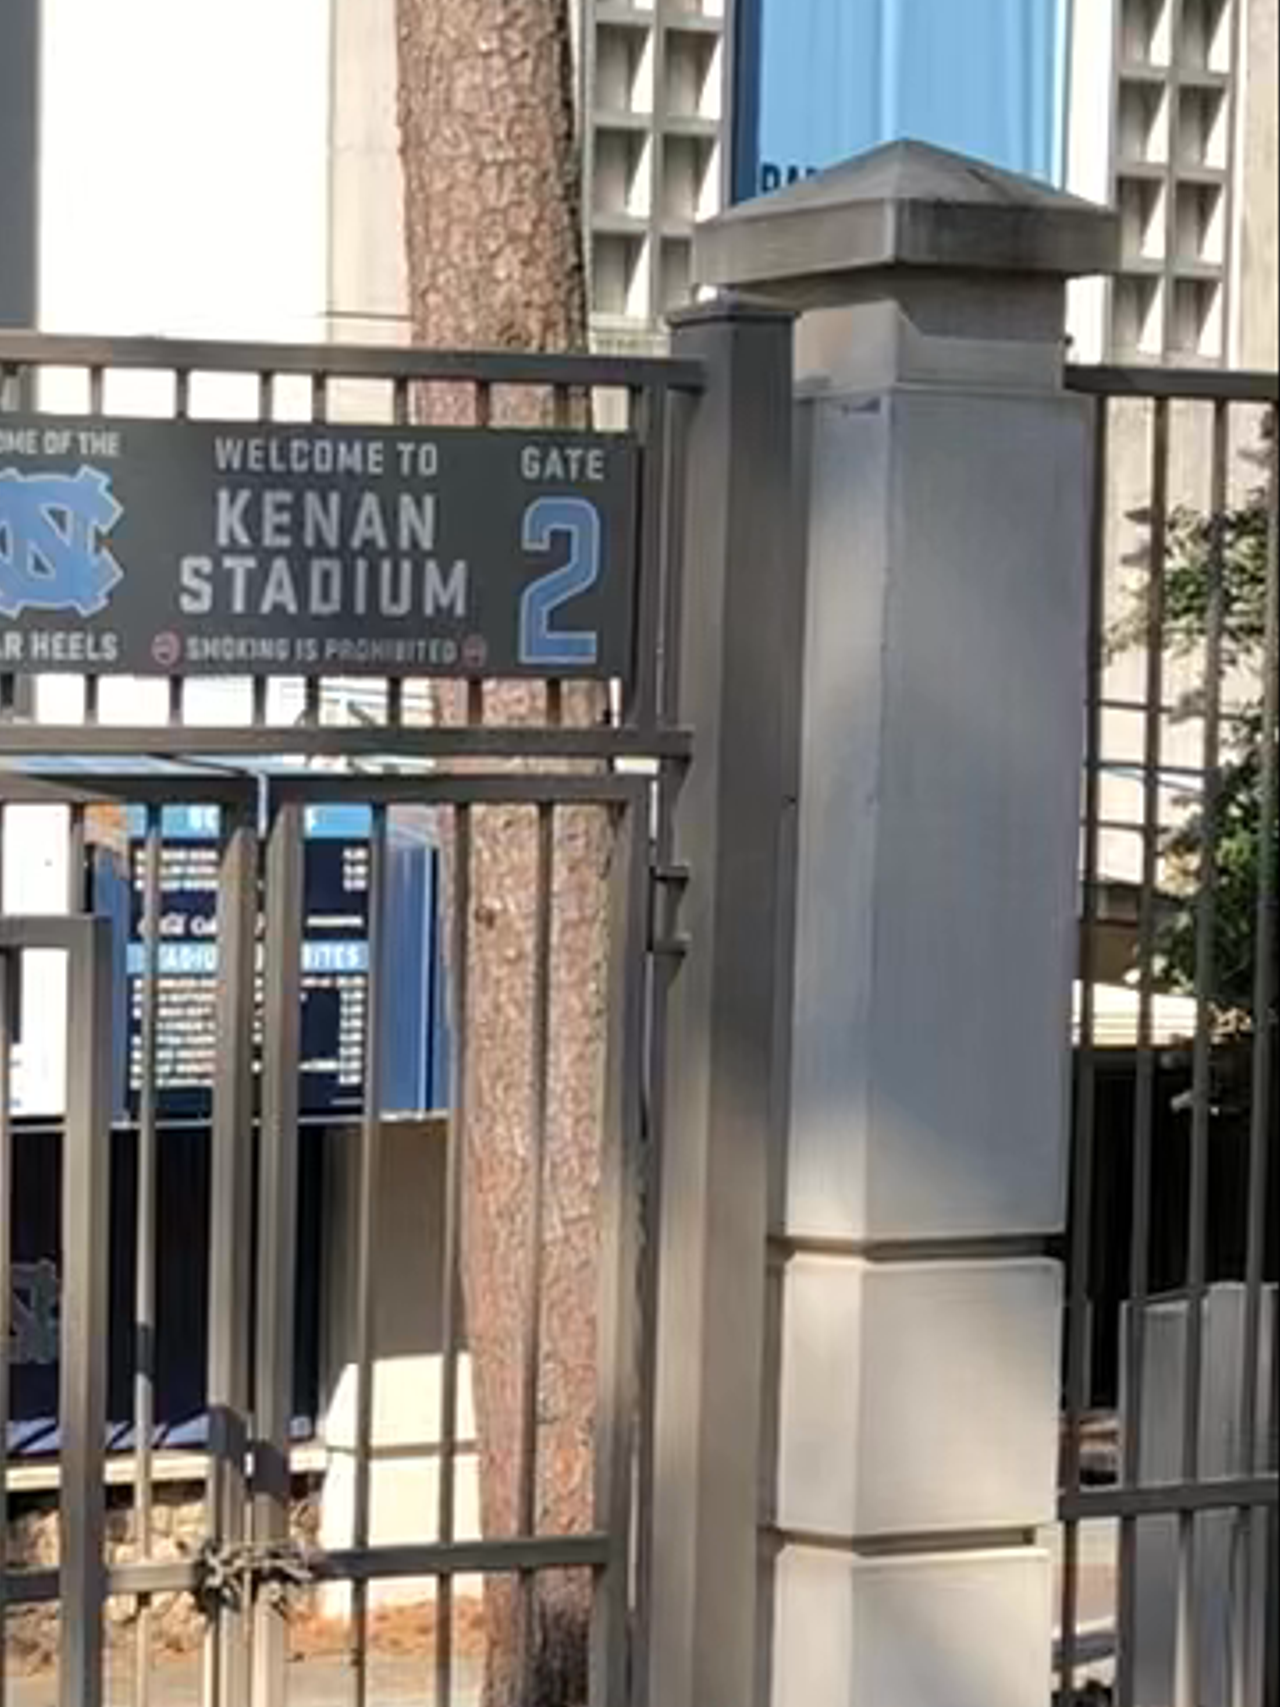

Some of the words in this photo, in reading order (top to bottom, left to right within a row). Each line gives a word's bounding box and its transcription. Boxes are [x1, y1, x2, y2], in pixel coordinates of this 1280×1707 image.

[44, 429, 71, 456] OF
[78, 430, 121, 458] THE
[214, 437, 385, 475] WELCOME
[395, 441, 438, 477] TO
[520, 446, 605, 481] GATE
[215, 488, 435, 551] KENAN
[179, 555, 467, 618] STADIUM
[517, 495, 601, 664] 2
[30, 631, 119, 662] HEELS
[186, 634, 290, 662] SMOKING
[295, 634, 320, 662] IS
[324, 637, 457, 666] PROHIBITED
